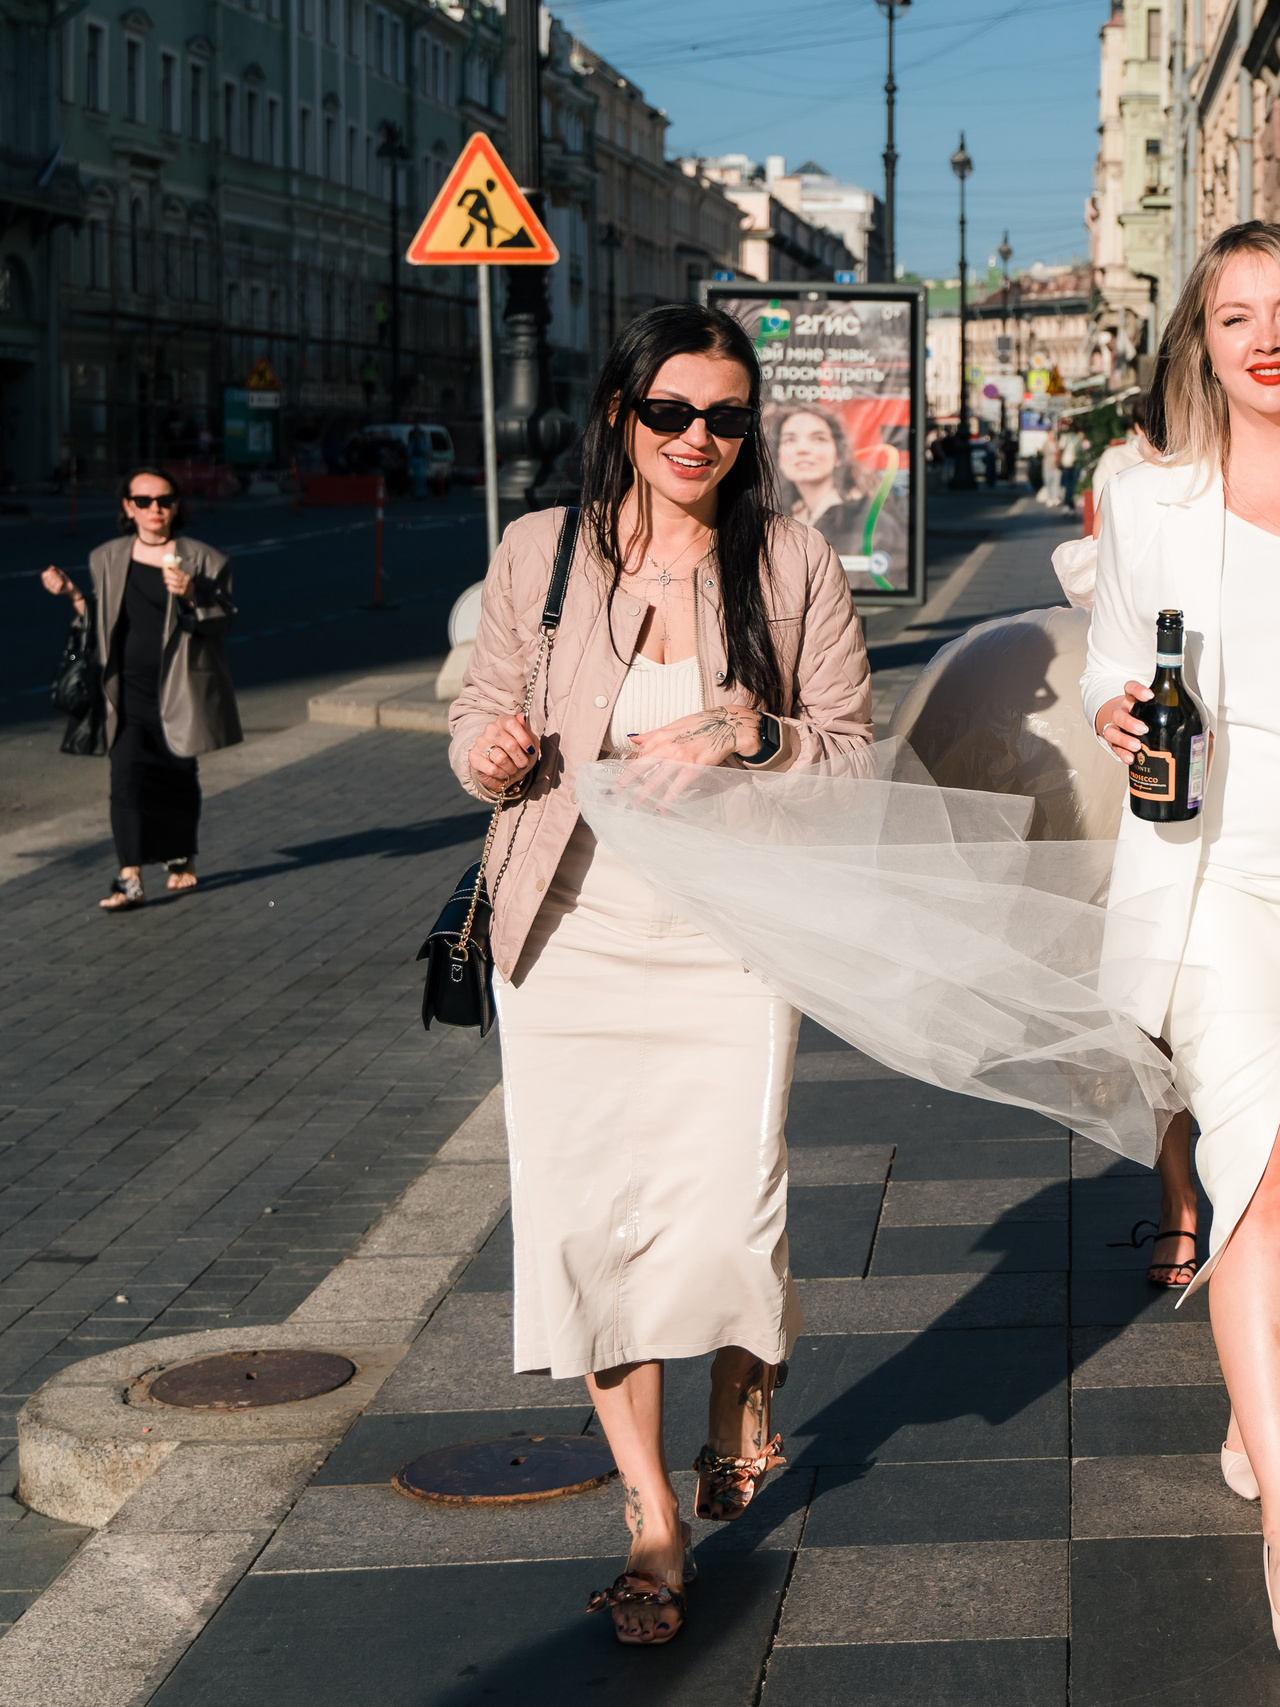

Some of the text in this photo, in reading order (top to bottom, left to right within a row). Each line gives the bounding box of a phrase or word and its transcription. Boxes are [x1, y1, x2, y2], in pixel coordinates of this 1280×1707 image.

[795, 314, 861, 336] 2ГИС
[759, 342, 876, 366] ай мне знак,
[775, 366, 884, 384] посмотреть
[771, 385, 853, 402] в городе
